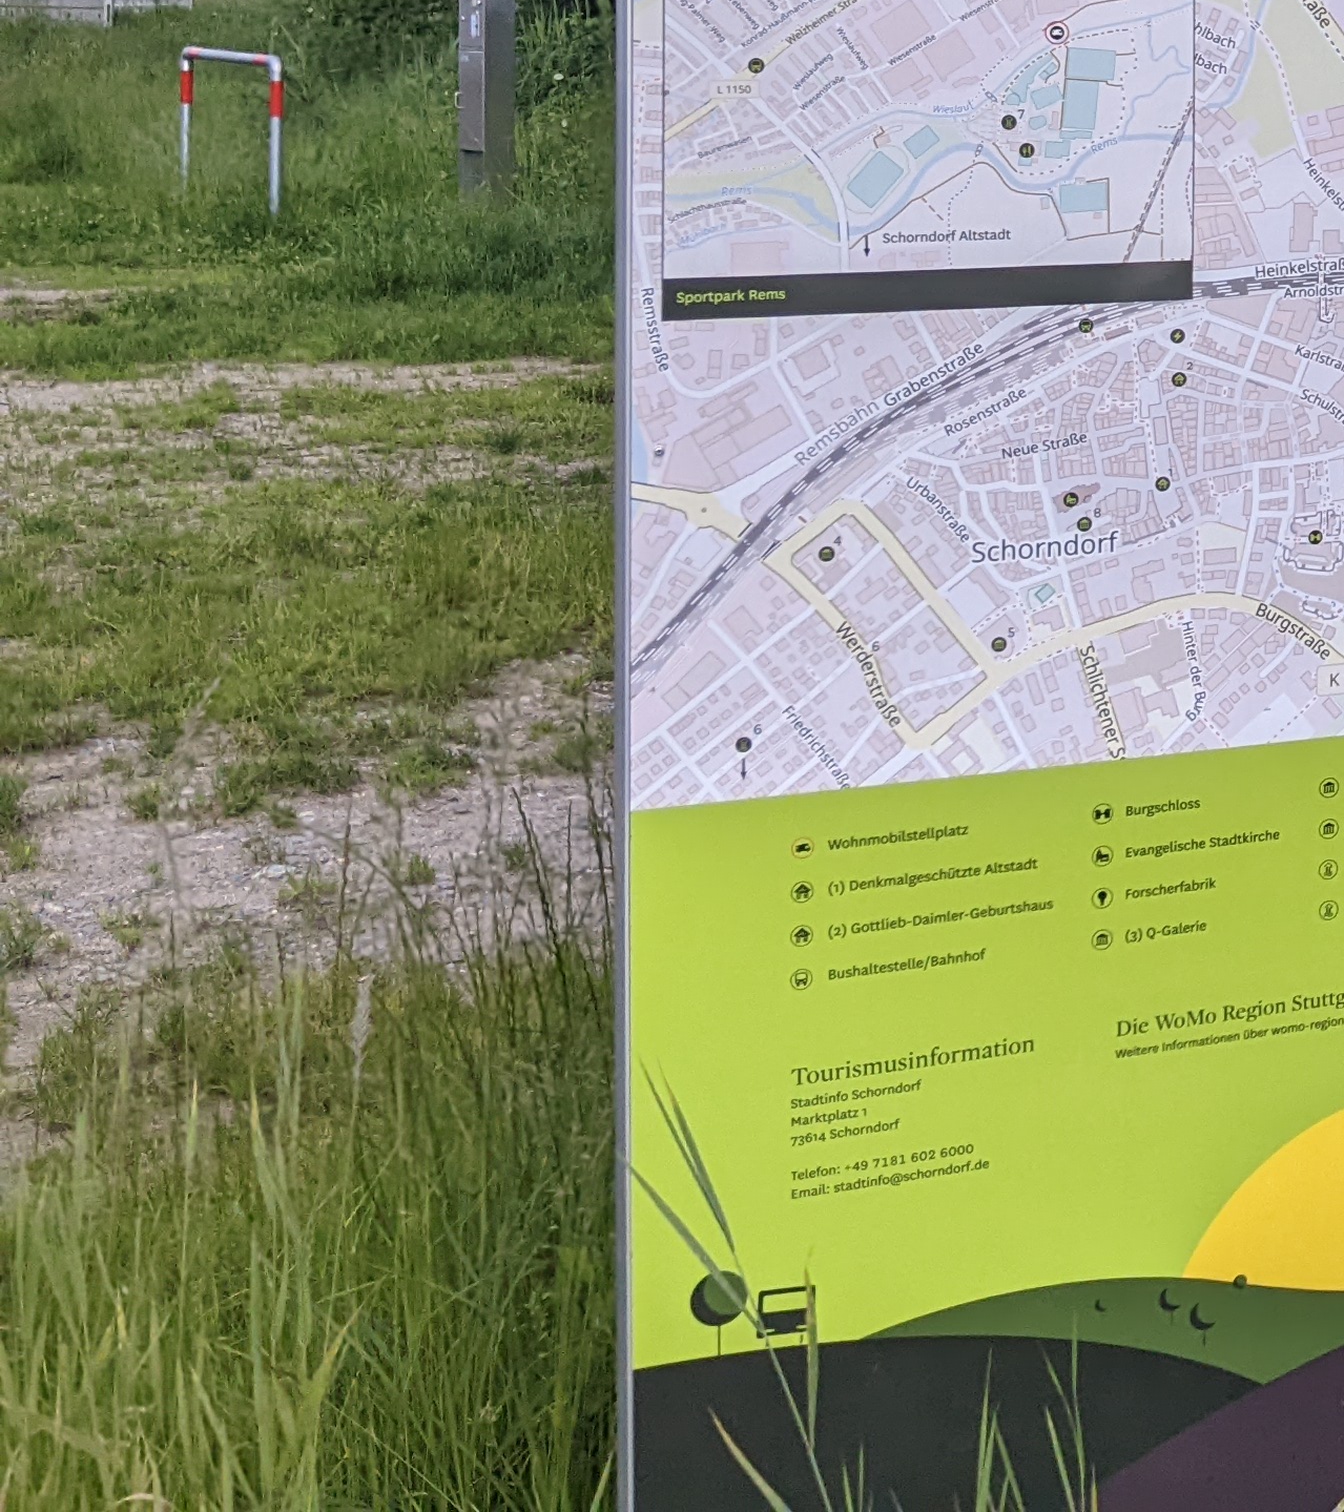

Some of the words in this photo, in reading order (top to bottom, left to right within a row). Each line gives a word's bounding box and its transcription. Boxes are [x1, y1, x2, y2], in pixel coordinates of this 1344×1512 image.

[786, 8, 837, 45] Welzheimer
[717, 86, 723, 94] L
[727, 86, 751, 94] 1150
[882, 228, 957, 244] Schorndorf
[959, 229, 1011, 241] Altstadt
[676, 290, 744, 305] Sportpark
[749, 290, 785, 301] Rems
[1001, 442, 1038, 459] Neue
[1041, 432, 1088, 453] Straße
[971, 531, 1118, 565] Schorndorf
[1254, 603, 1332, 660] Burgstraße
[835, 621, 901, 728] Werderstraße
[1329, 673, 1339, 687] K
[1125, 798, 1201, 818] Burgschloss
[828, 824, 969, 852] Wohnmobilstellplatz
[1125, 839, 1206, 860] Evangelische
[1209, 829, 1280, 849] Stadtkirche
[828, 879, 846, 897] (1)
[849, 866, 981, 892] Denkmalgeschützte
[984, 857, 1038, 877] Altstadt
[1125, 877, 1216, 900] Forscherfabrik
[828, 923, 847, 940] (2)
[850, 898, 1054, 935] Gottlieb-Daimler-Geburtshaus
[1125, 928, 1142, 944] (3)
[1145, 920, 1207, 940] Q-Galerie
[828, 949, 986, 982] Bushaltestelle/Bahnhof
[1117, 1015, 1149, 1038] Die
[1155, 1009, 1217, 1031] WoMo
[1222, 997, 1286, 1025] Region
[1115, 1043, 1159, 1059] Weitere
[1162, 1031, 1241, 1053] Informationen
[1244, 1027, 1269, 1040] über
[791, 1035, 1035, 1087] Tourismusinformation
[790, 1091, 849, 1109] Stadtinfo
[852, 1079, 922, 1102] Schorndorf
[791, 1164, 841, 1182] Telefon:
[844, 1159, 869, 1173] +49
[872, 1152, 907, 1169] 7181
[911, 1149, 936, 1164] 602
[940, 1143, 974, 1159] 6000
[791, 1181, 830, 1200] Email:
[833, 1158, 989, 1194] stadtinfo@schorndorf.de
